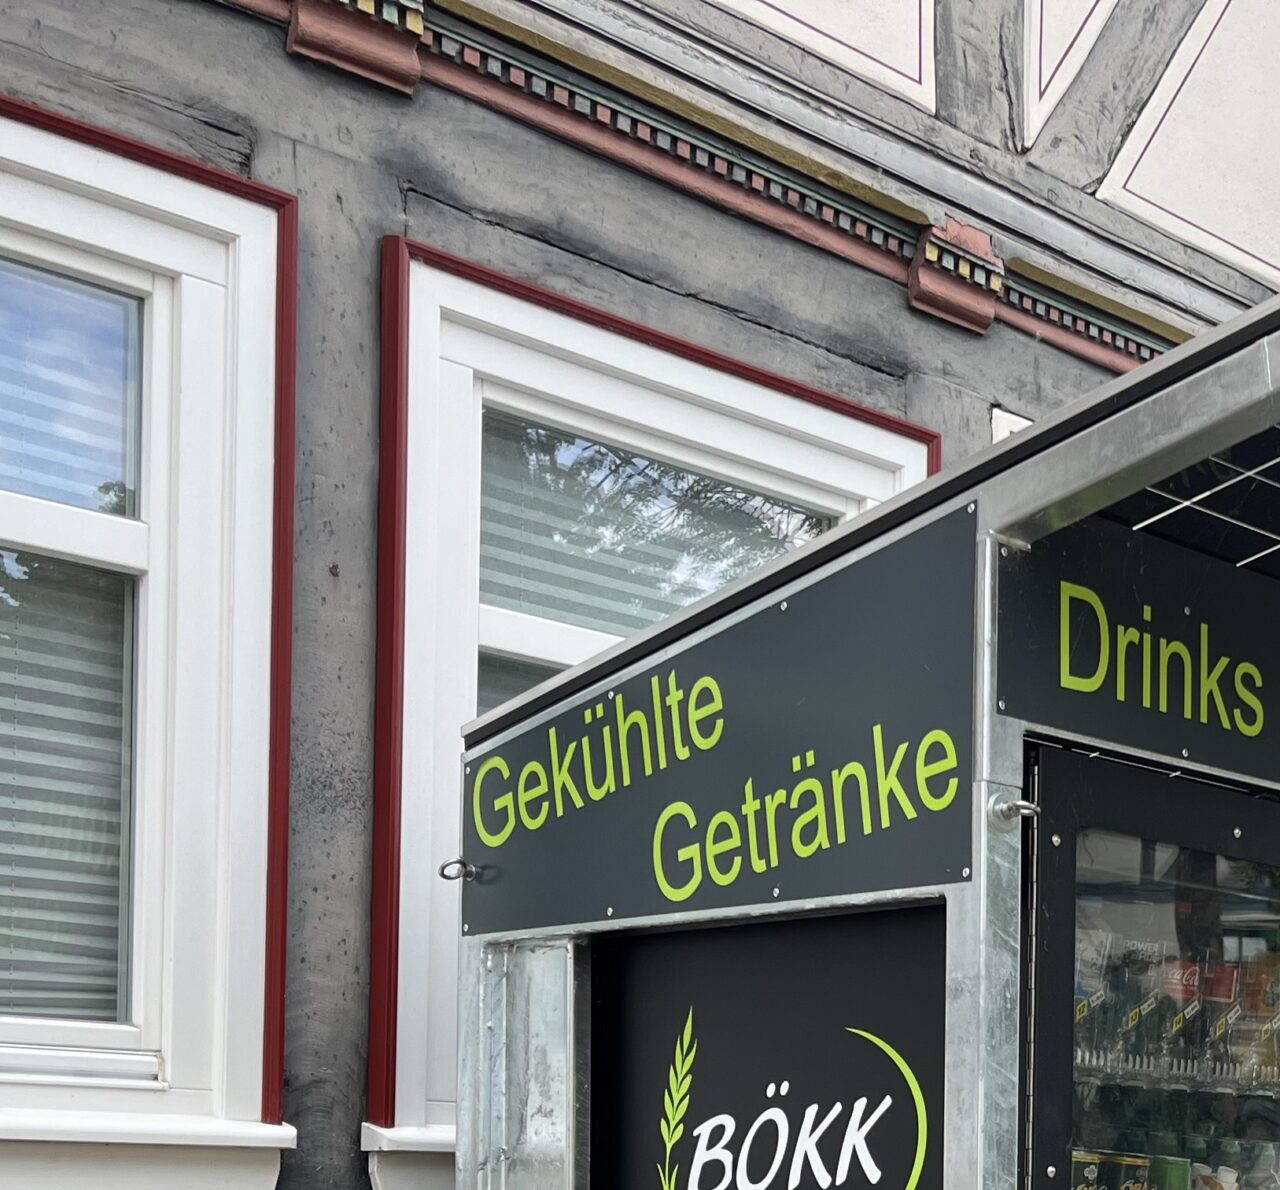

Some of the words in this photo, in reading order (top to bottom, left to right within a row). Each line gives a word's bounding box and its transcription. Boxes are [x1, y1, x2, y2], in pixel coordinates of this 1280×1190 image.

[1060, 580, 1265, 737] Drinks
[472, 669, 724, 848] Gekühlte
[653, 724, 959, 902] Getränke
